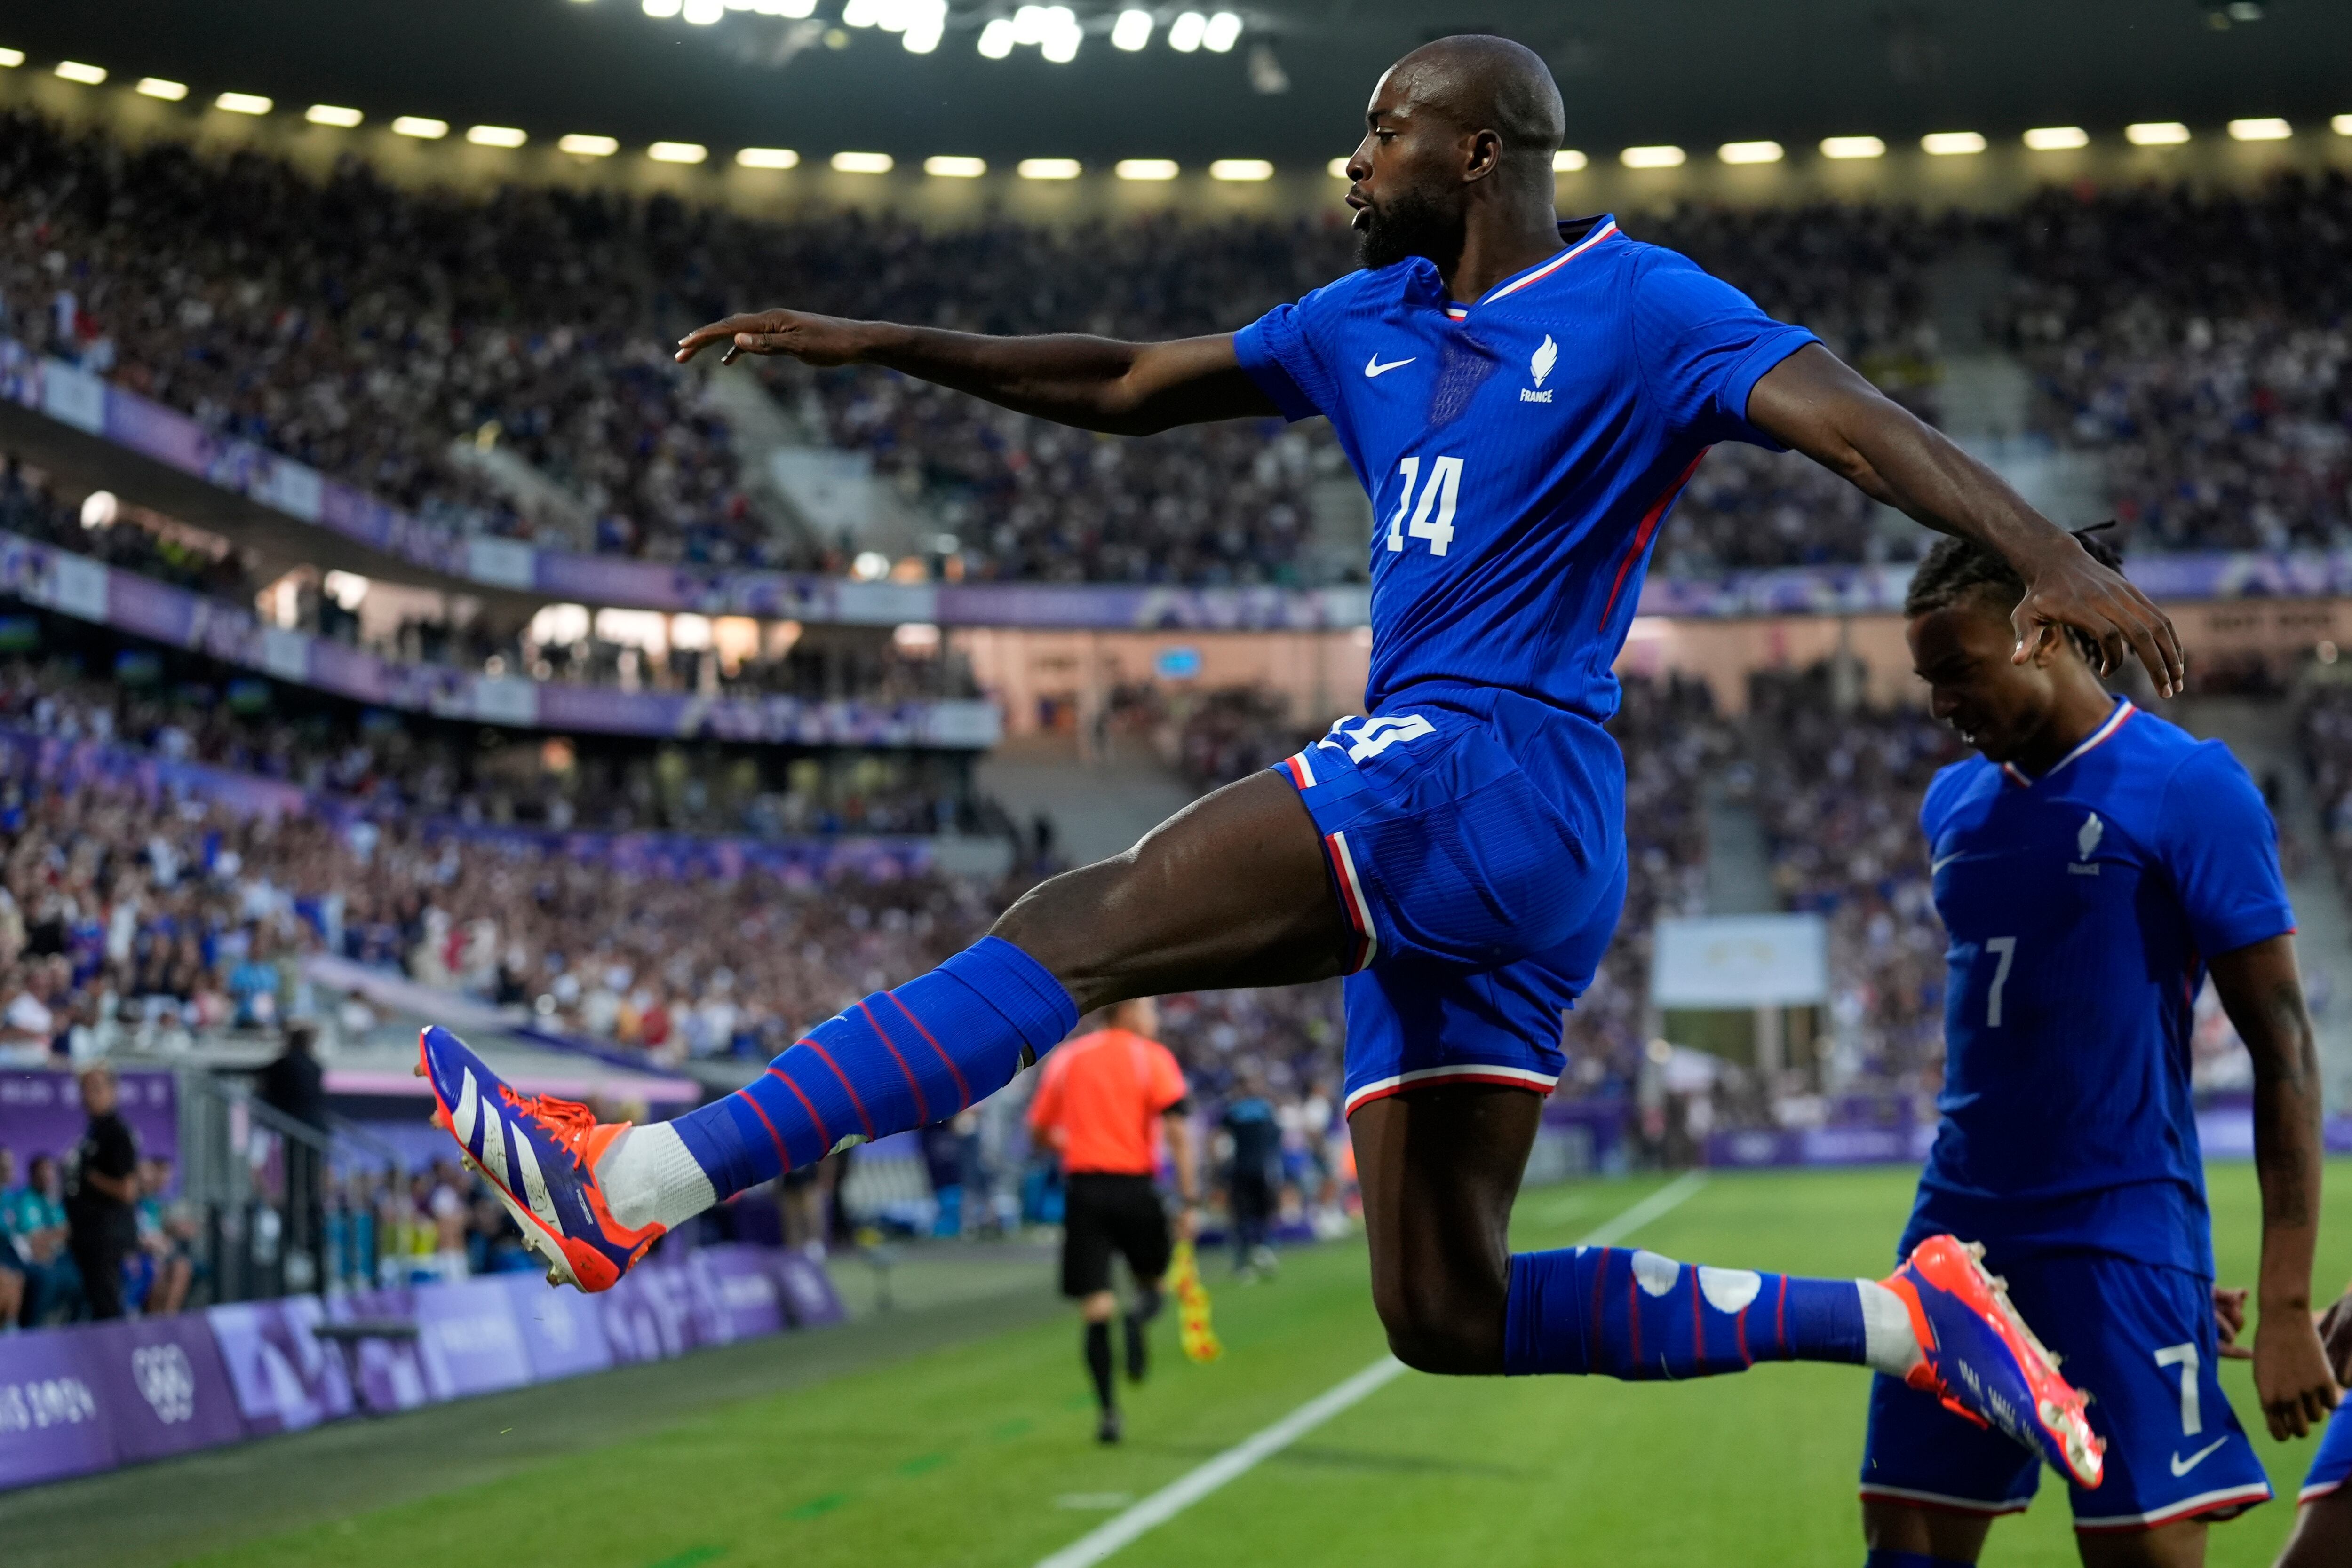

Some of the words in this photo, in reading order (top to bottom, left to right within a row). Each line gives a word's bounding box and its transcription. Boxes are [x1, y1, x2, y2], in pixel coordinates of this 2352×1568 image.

[1519, 388, 1553, 403] FRANCE
[1387, 455, 1464, 557] 14
[1986, 936, 2017, 1028] 7
[26, 1377, 96, 1428] 2024
[2153, 1342, 2202, 1437] 7
